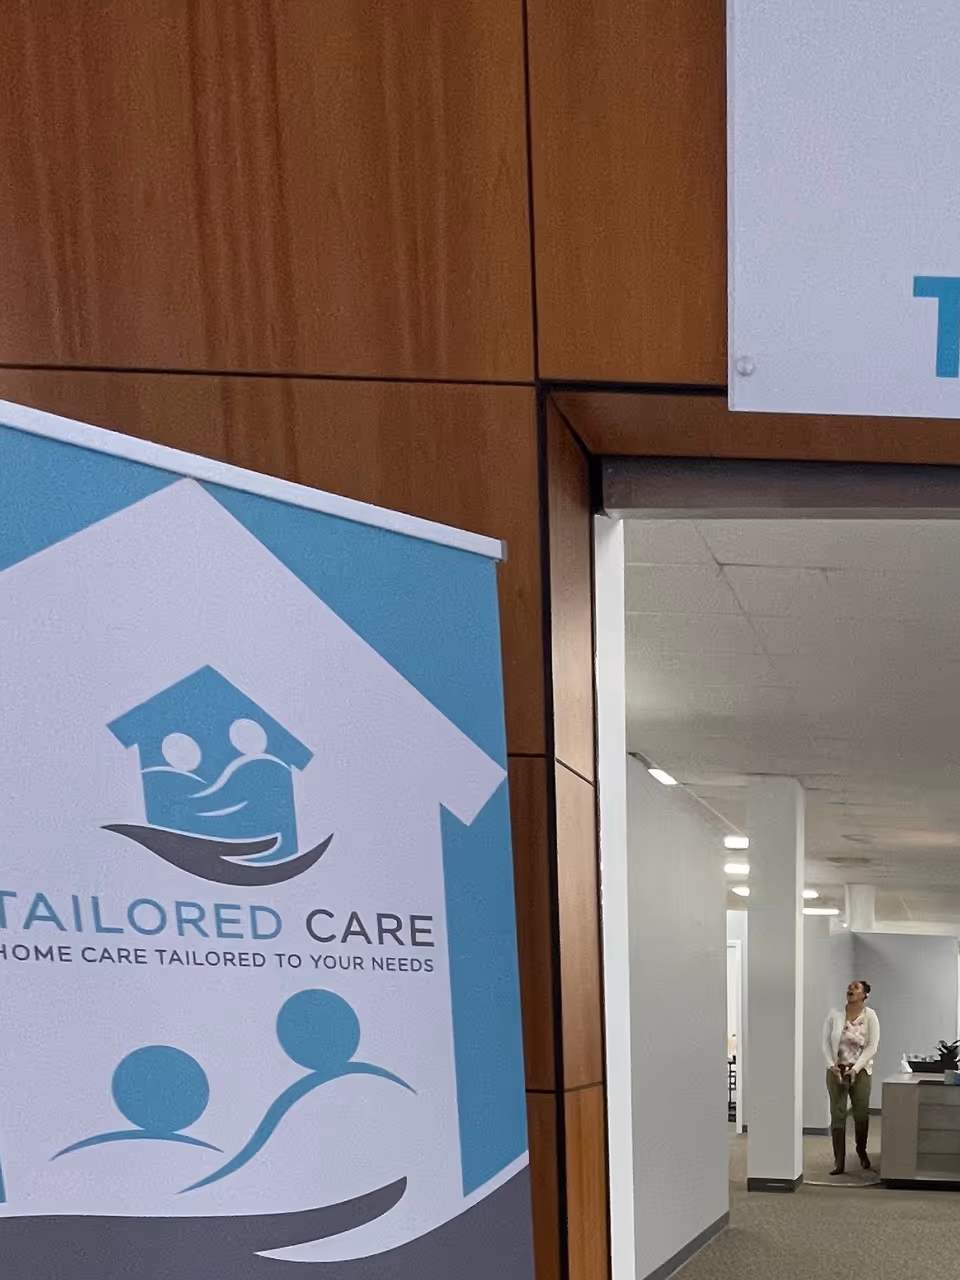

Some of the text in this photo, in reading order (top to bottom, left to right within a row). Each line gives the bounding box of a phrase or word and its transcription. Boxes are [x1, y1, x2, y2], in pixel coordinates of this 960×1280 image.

[0, 890, 435, 948] TAILORED CARE
[81, 946, 149, 966] CARE
[155, 949, 267, 969] TAILORED
[275, 953, 302, 969] TO
[310, 954, 365, 971] YOUR
[371, 957, 434, 973] NEEDS
